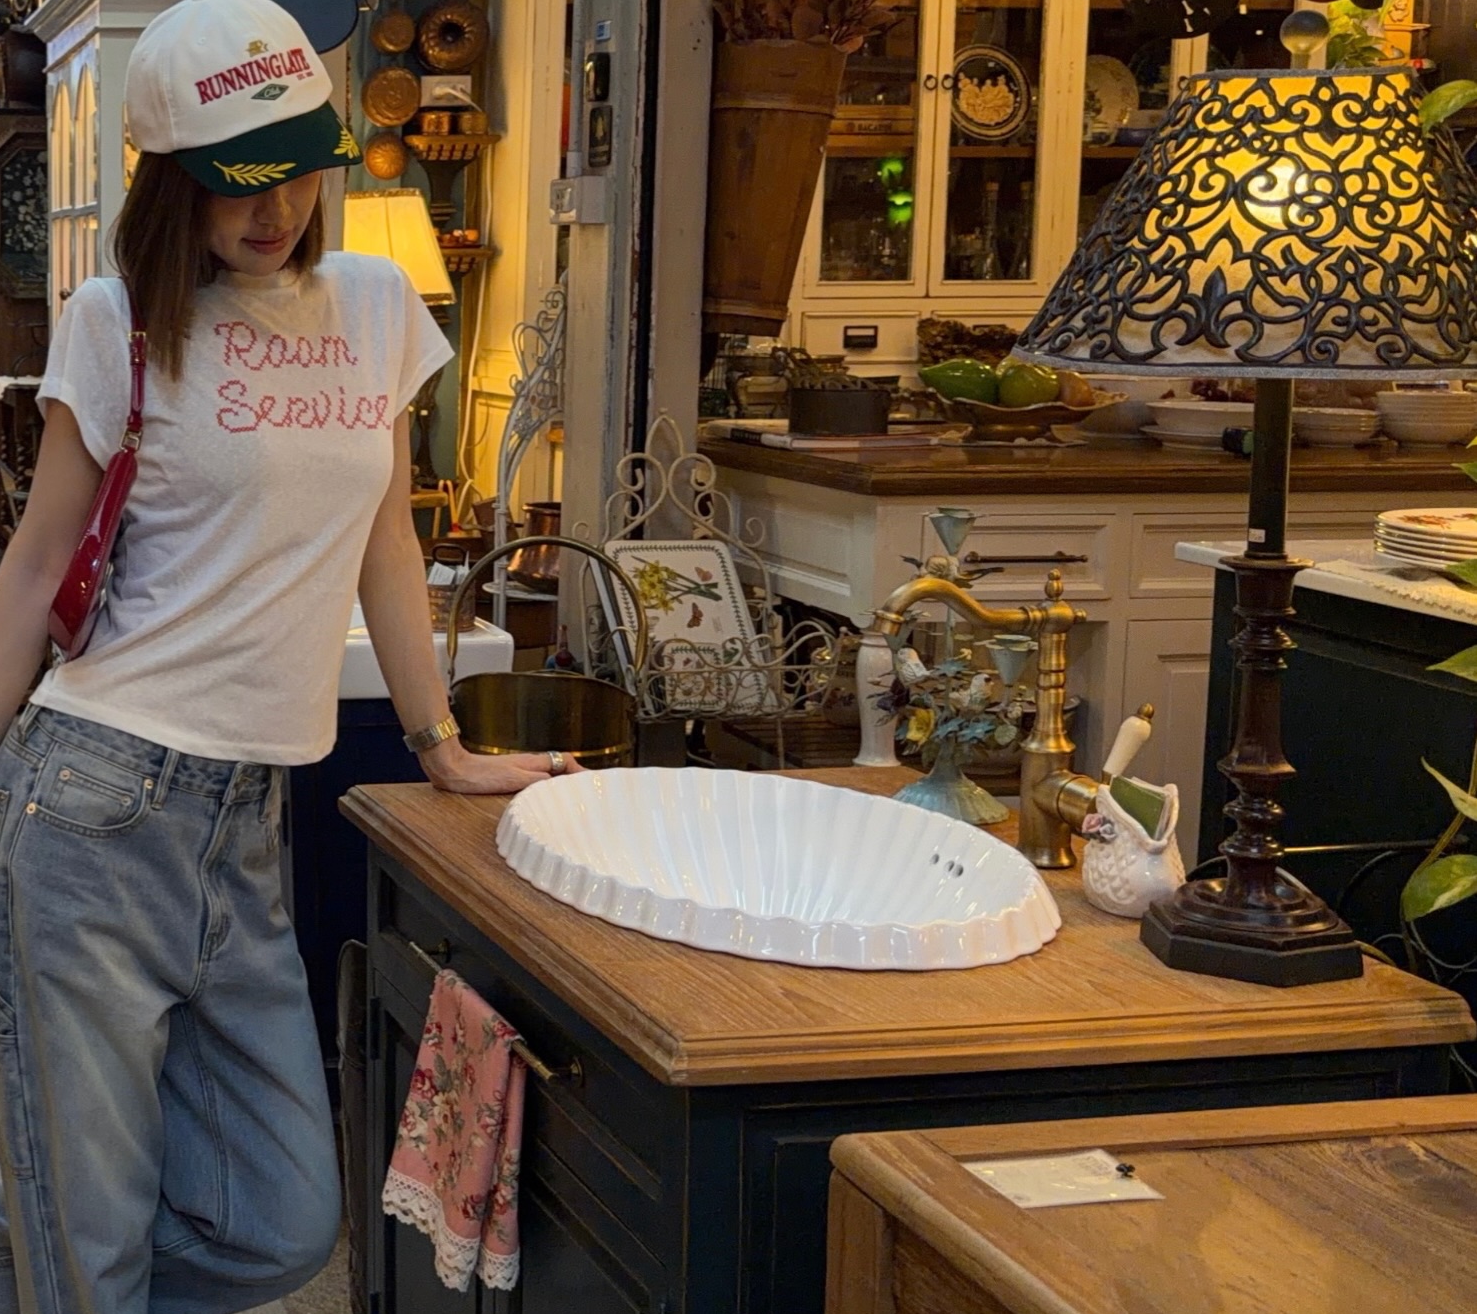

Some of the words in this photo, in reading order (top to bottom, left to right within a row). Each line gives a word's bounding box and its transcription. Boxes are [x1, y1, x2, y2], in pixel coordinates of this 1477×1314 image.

[195, 55, 283, 104] RUNNING
[213, 320, 358, 371] Room
[216, 379, 391, 433] Service
